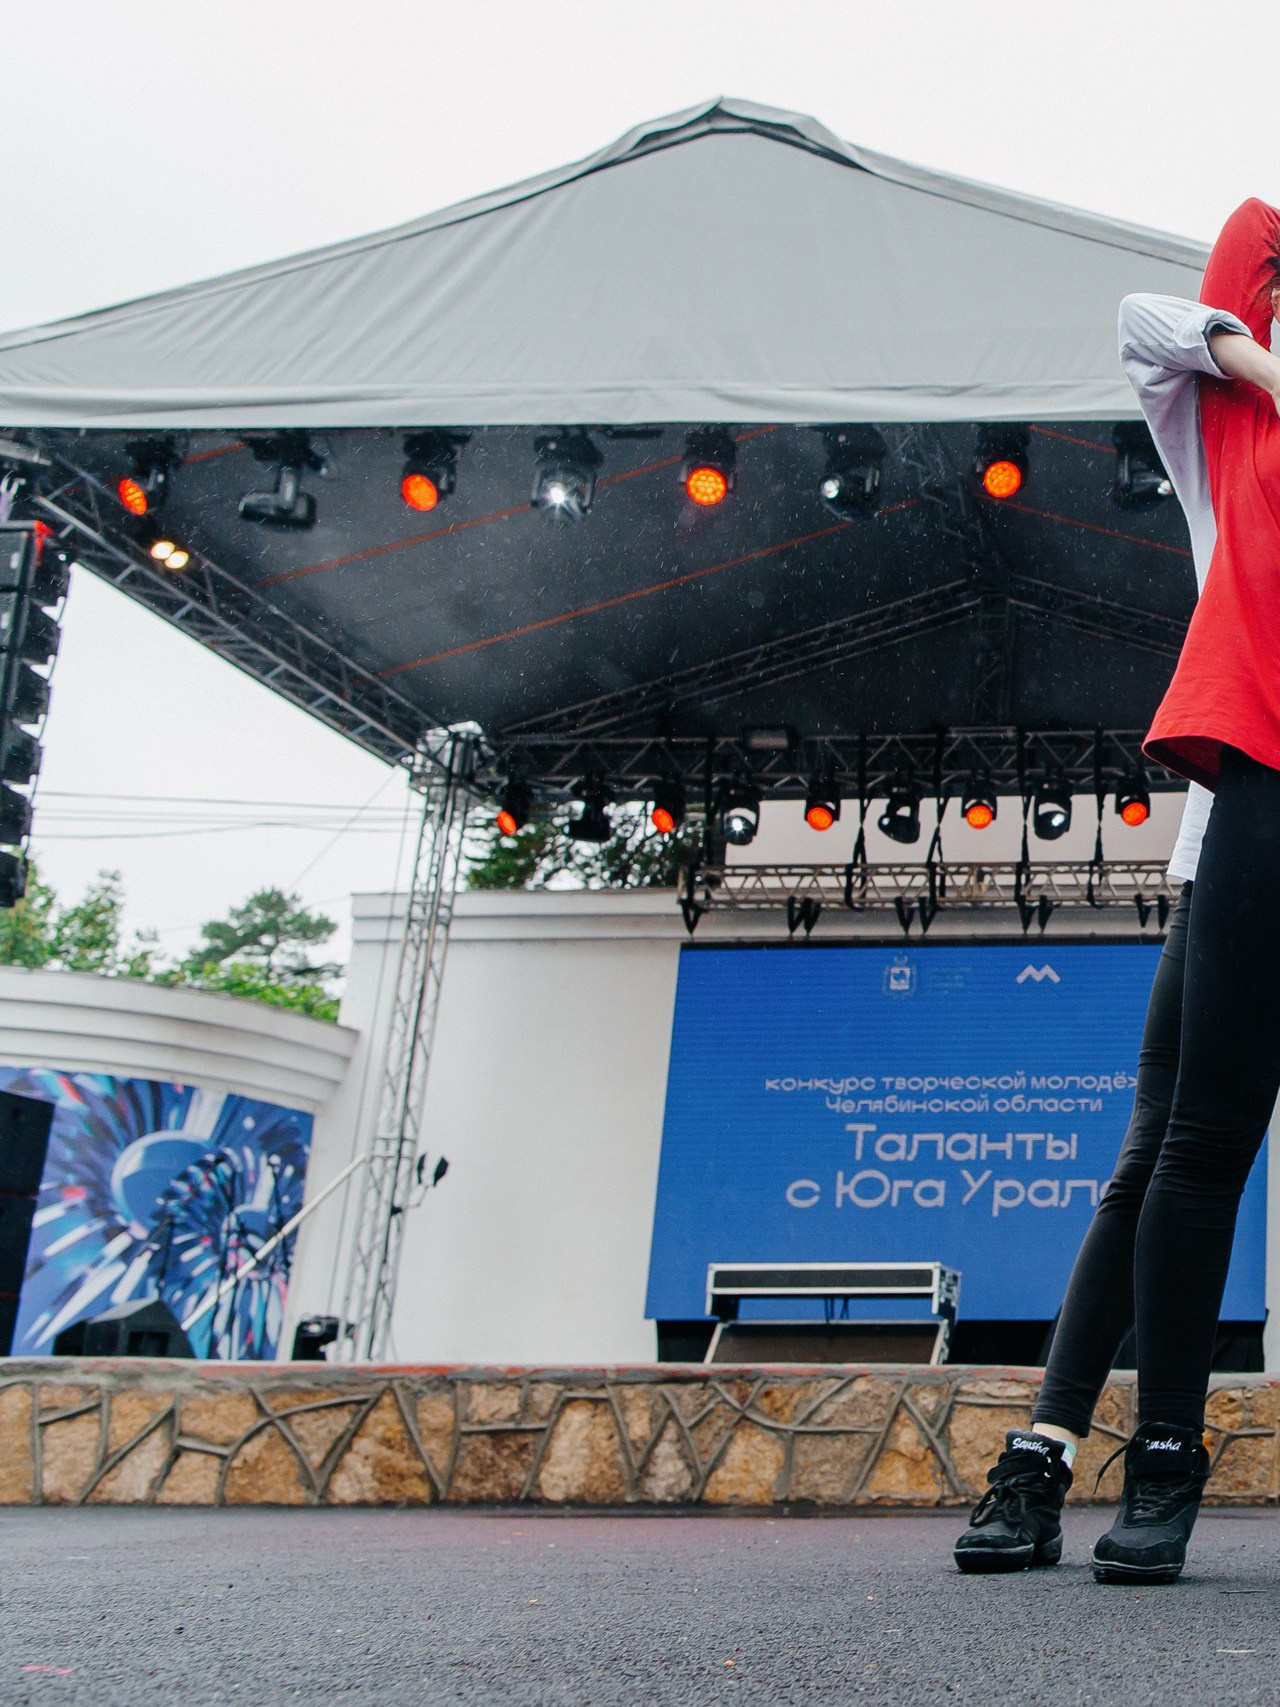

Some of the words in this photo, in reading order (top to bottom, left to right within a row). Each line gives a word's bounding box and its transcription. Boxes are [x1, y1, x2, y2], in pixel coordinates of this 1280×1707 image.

[765, 1076, 876, 1095] конкурс
[881, 1070, 1026, 1094] творческой
[825, 1093, 989, 1113] Челябинской
[993, 1094, 1103, 1113] области
[845, 1122, 1078, 1162] Таланты
[785, 1179, 821, 1208] с
[835, 1169, 946, 1208] Юга
[1012, 1437, 1050, 1456] Sansha
